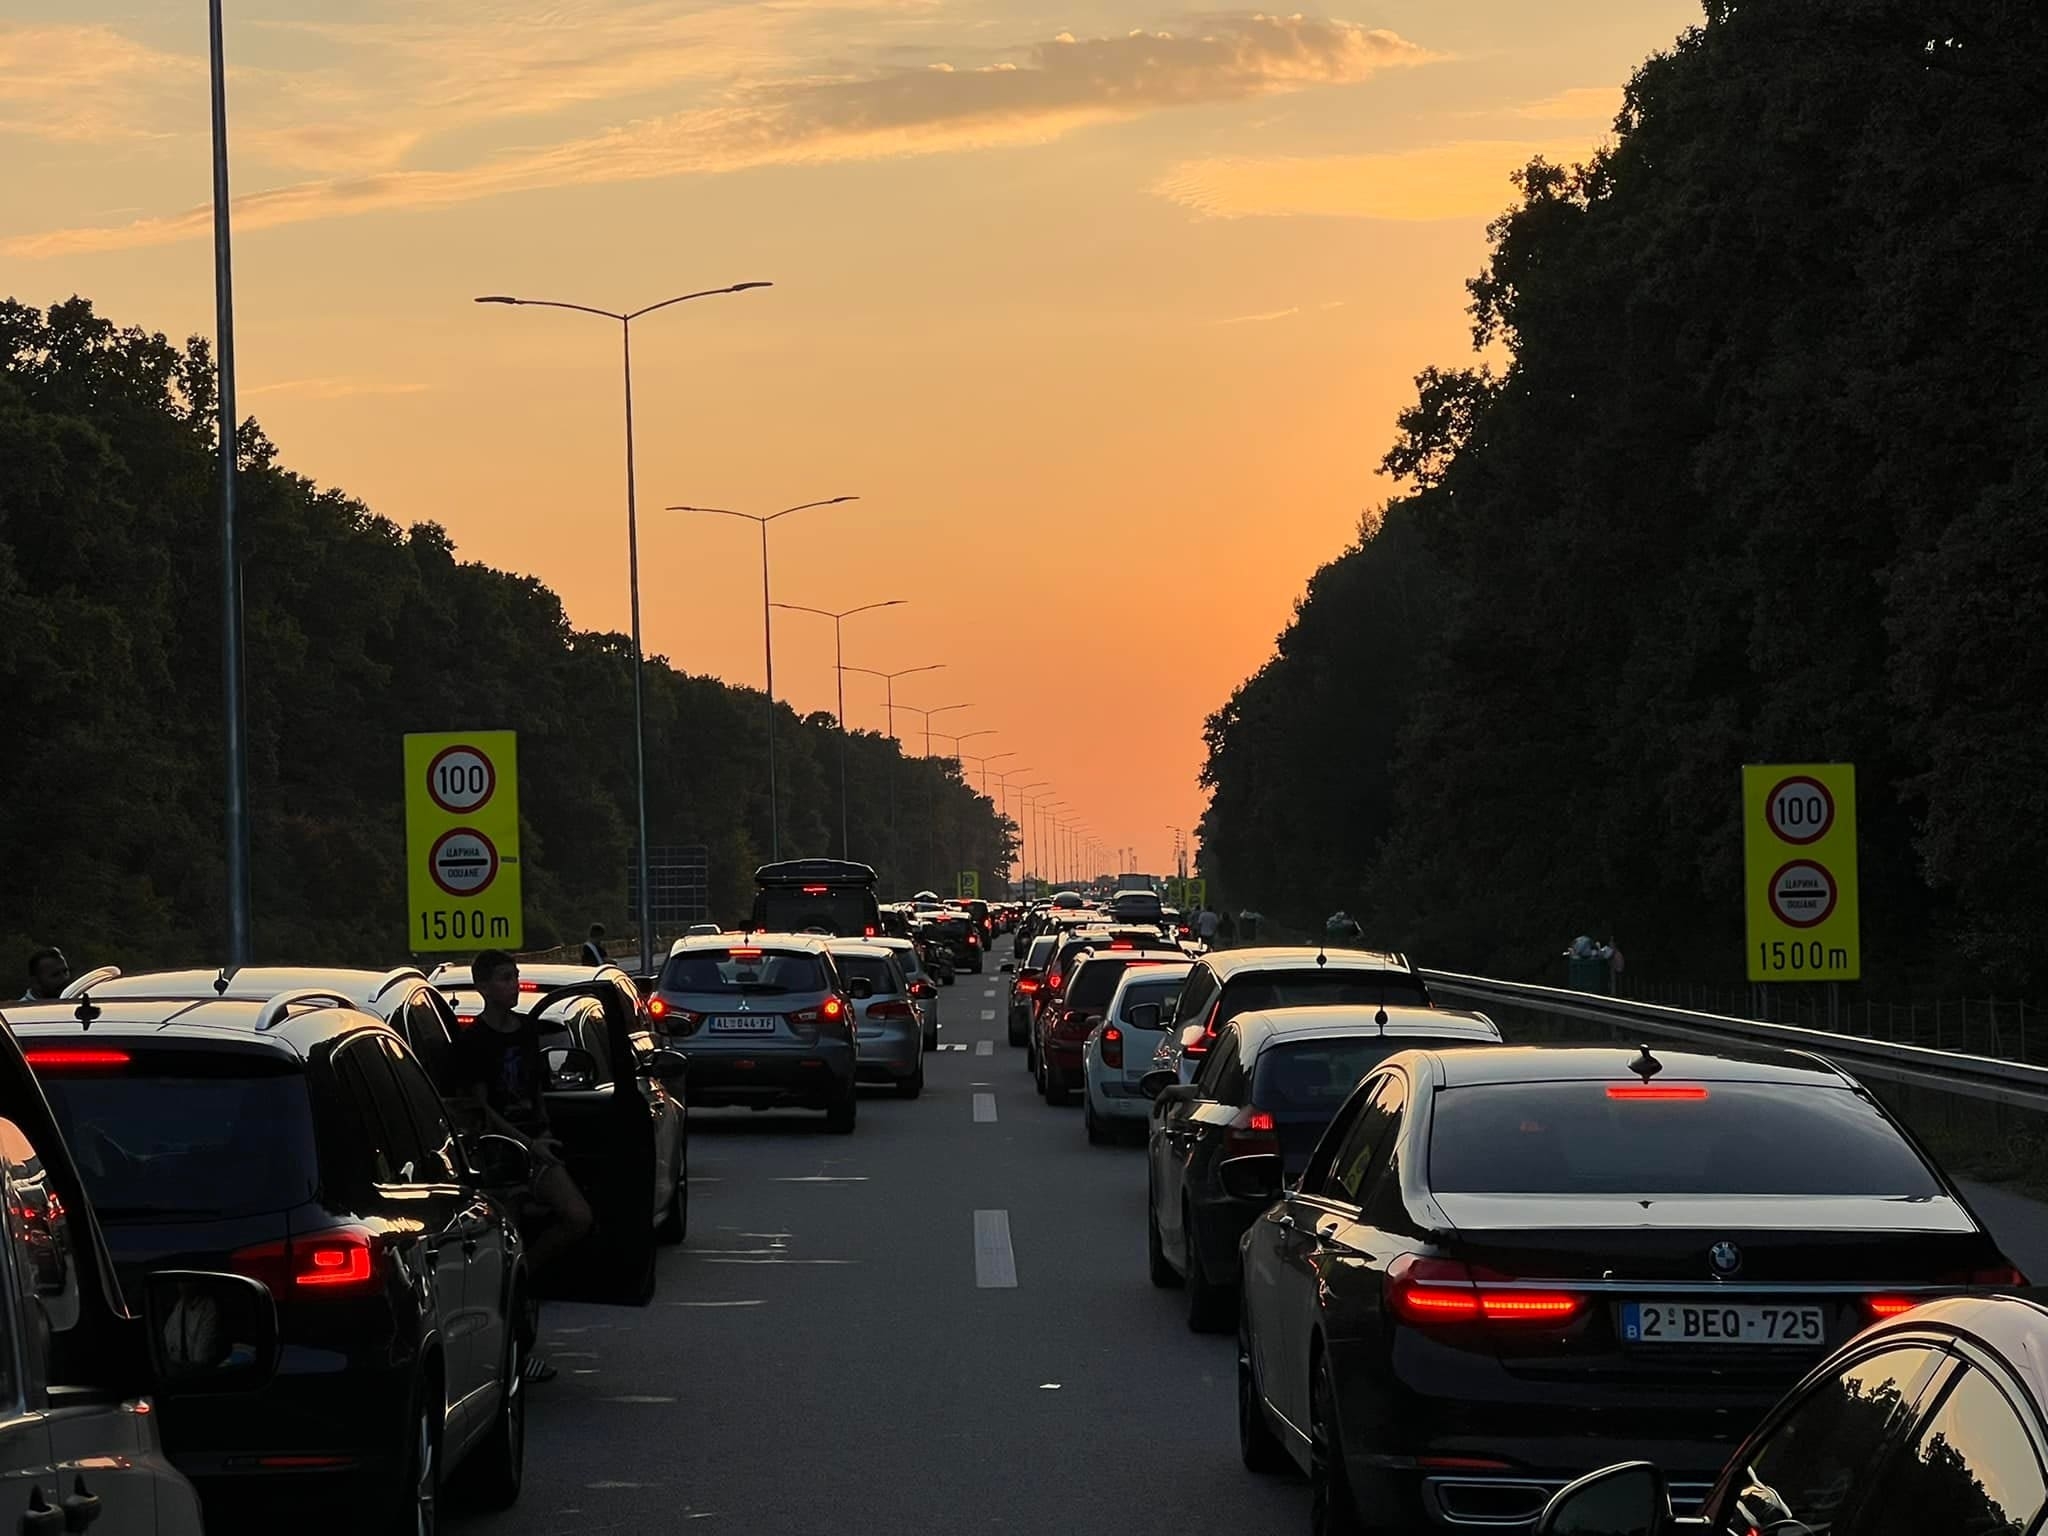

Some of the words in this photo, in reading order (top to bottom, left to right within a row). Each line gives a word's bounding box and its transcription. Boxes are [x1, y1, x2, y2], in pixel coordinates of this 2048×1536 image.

[439, 765, 484, 795] 100
[1778, 796, 1823, 825] 100
[446, 847, 480, 857] ЦАРИНА
[447, 868, 480, 878] DOUANE
[1785, 879, 1819, 889] ЦАРИНА
[421, 910, 509, 940] 1500m
[1760, 940, 1847, 970] 1500m
[1627, 1325, 1638, 1338] B
